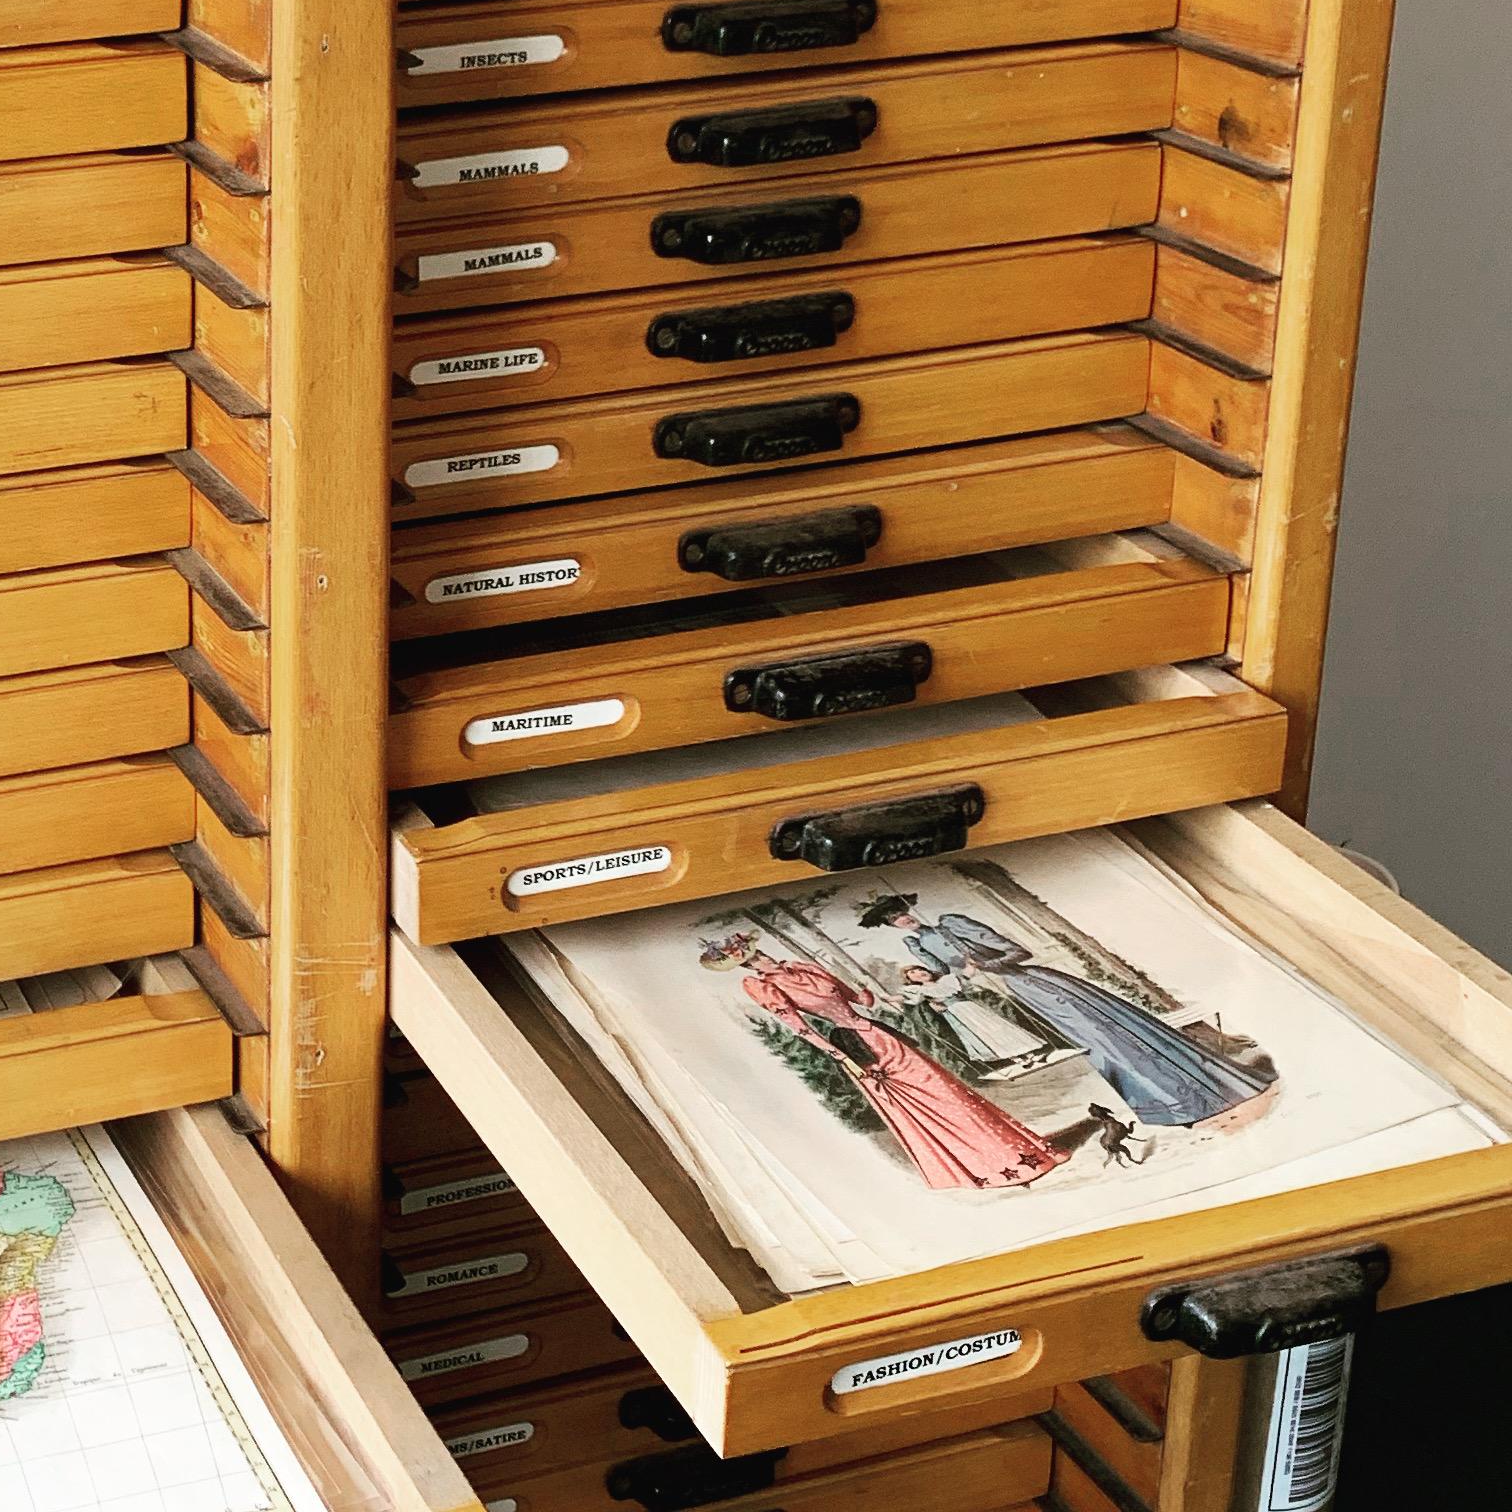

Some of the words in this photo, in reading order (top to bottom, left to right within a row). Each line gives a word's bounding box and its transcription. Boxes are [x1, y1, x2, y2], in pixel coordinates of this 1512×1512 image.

[460, 51, 528, 68] INSECTS
[458, 162, 540, 182] MAMMALS
[463, 246, 543, 271] MAMMALS
[437, 357, 501, 375] MARINE
[503, 352, 539, 368] LIFE
[446, 453, 522, 473] REPTILES
[442, 575, 515, 597] NATURAL
[490, 712, 575, 733] MARITIME
[522, 847, 665, 887] SPORTS/LEISURE
[426, 1264, 500, 1286] ROMANCE
[420, 1352, 484, 1374] MEDICAL
[851, 1330, 1021, 1387] FASHION/COSTUM
